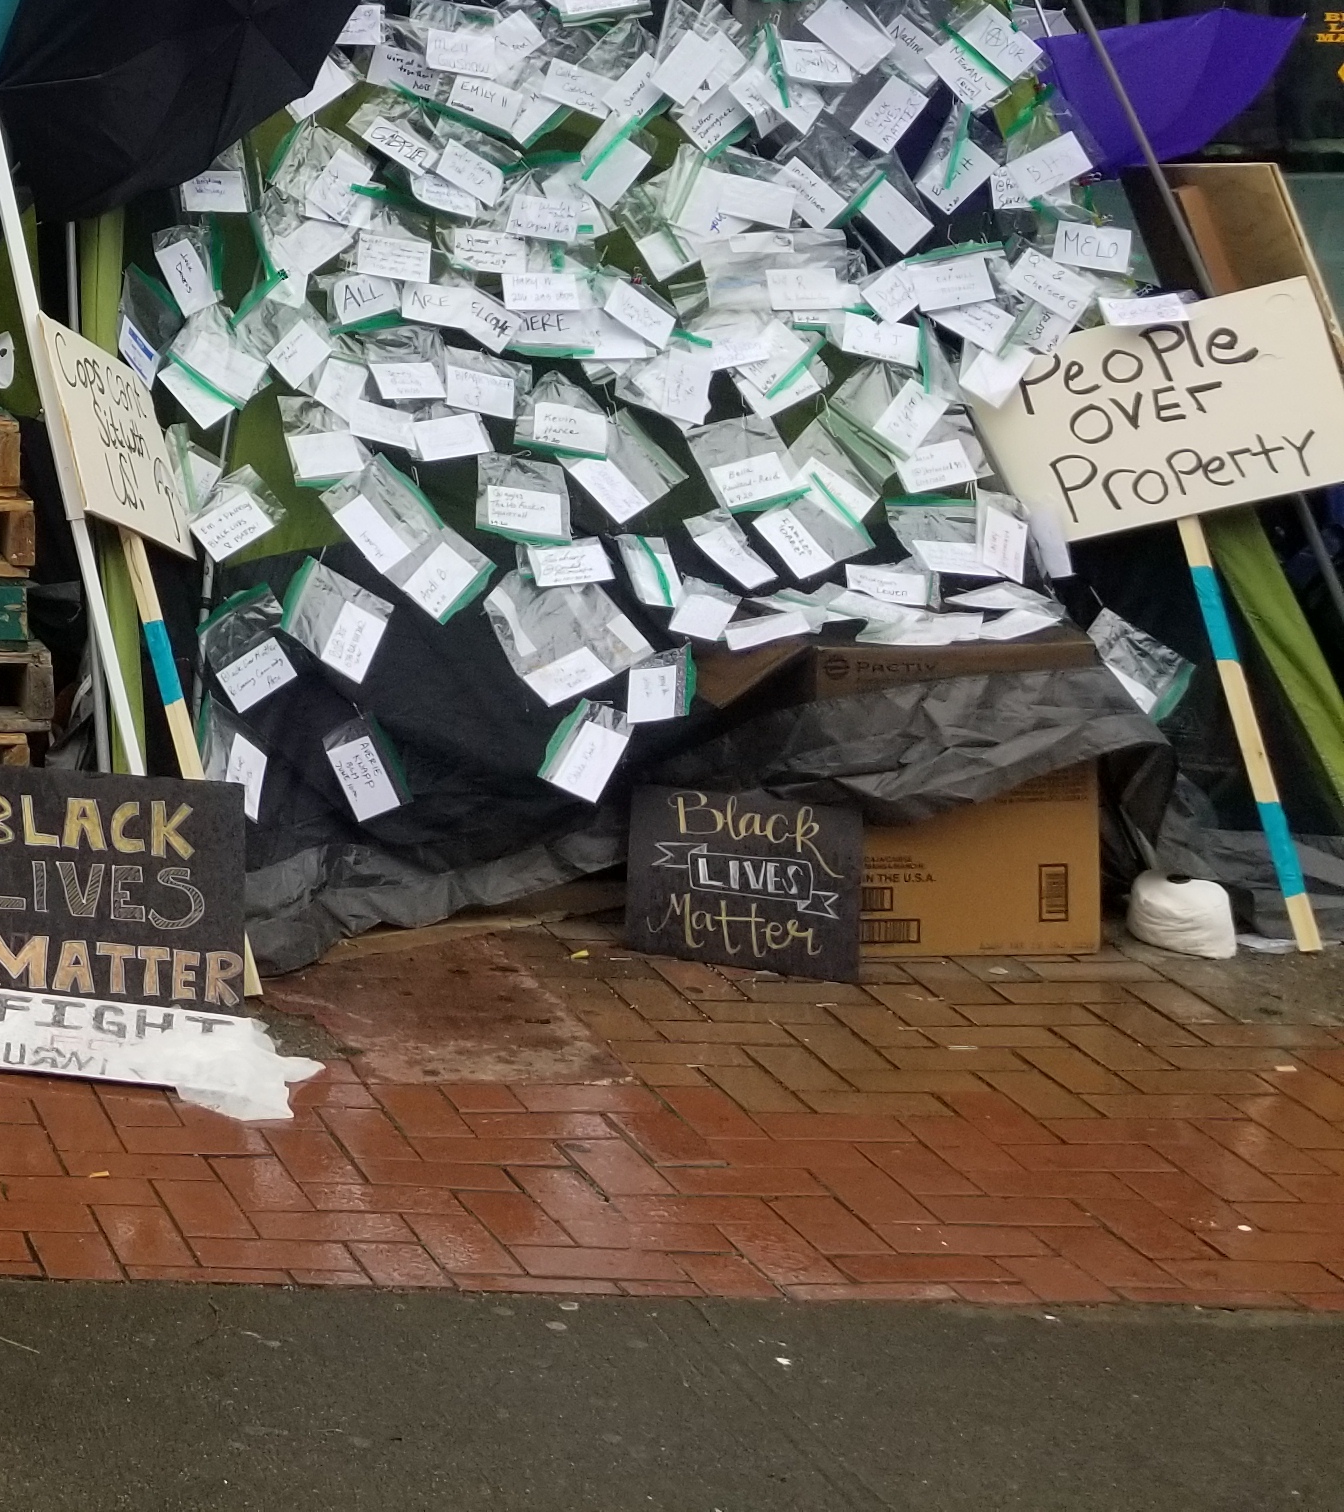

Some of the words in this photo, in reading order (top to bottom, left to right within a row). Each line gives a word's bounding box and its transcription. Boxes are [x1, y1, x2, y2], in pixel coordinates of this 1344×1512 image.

[1063, 230, 1119, 259] MELO
[343, 284, 384, 314] ALL
[411, 290, 451, 309] ARE
[668, 791, 845, 879] Black
[698, 857, 805, 896] LIVES
[877, 873, 901, 883] THE
[646, 892, 822, 958] Matter
